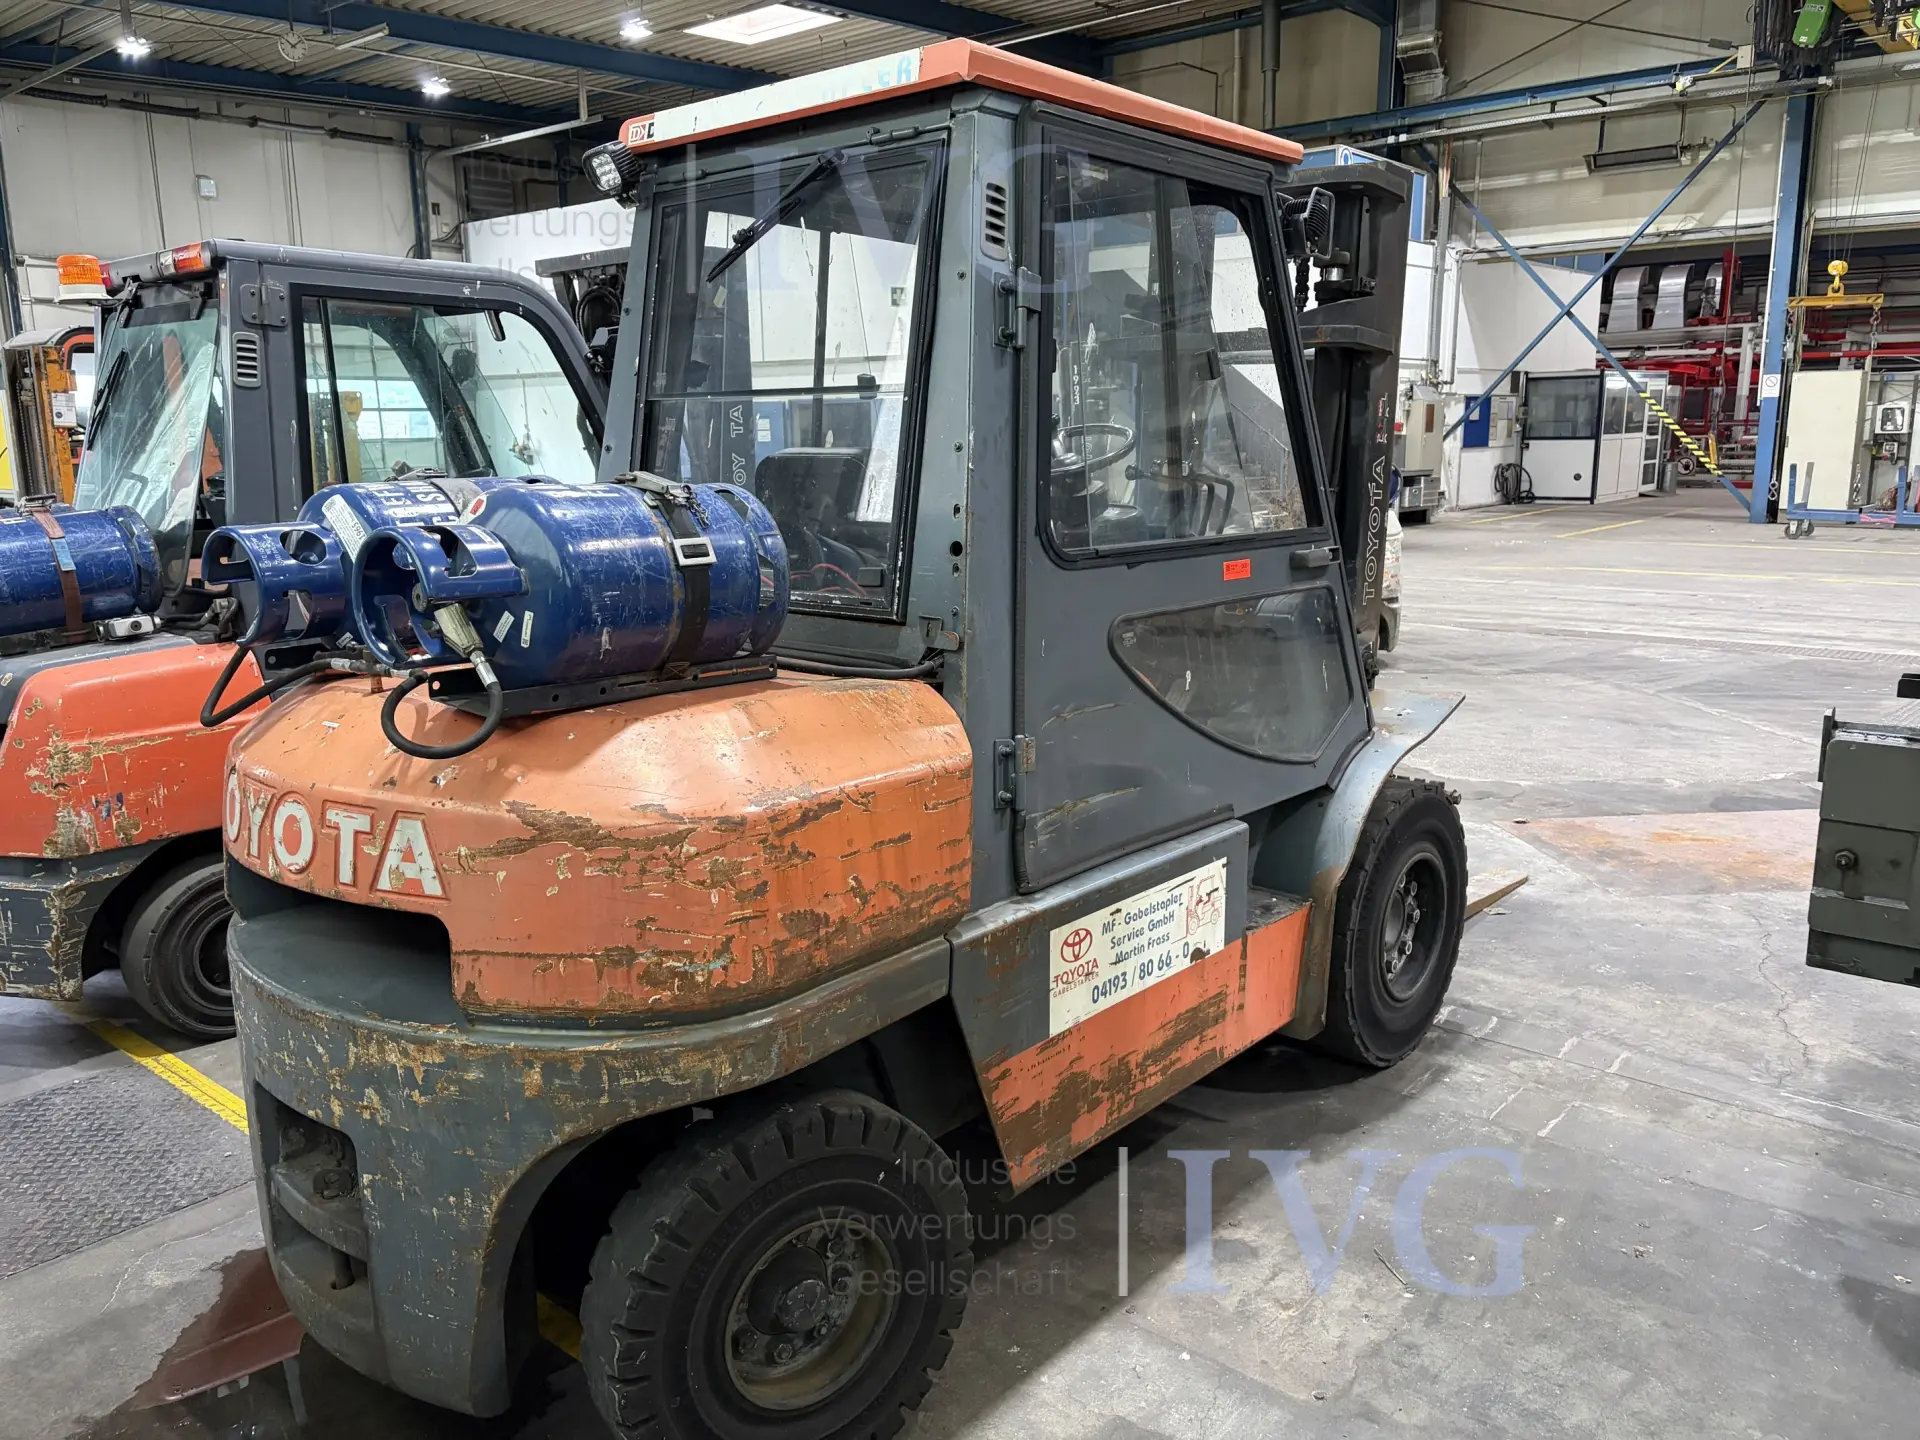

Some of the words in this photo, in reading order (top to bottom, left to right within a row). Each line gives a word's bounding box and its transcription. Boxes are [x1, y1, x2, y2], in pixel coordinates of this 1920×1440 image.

[1362, 455, 1386, 605] TOYOTA
[1123, 892, 1183, 926] Gabelstapler
[1110, 928, 1145, 950] Service
[1147, 911, 1175, 932] GmbH
[1114, 944, 1145, 965] Martin
[1147, 931, 1170, 952] Frass
[1052, 972, 1100, 998] GABELSTAPLER
[1053, 957, 1099, 989] TOYOTA
[1092, 971, 1128, 1004] 04193
[1138, 959, 1154, 981] 80
[1157, 950, 1172, 972] 66
